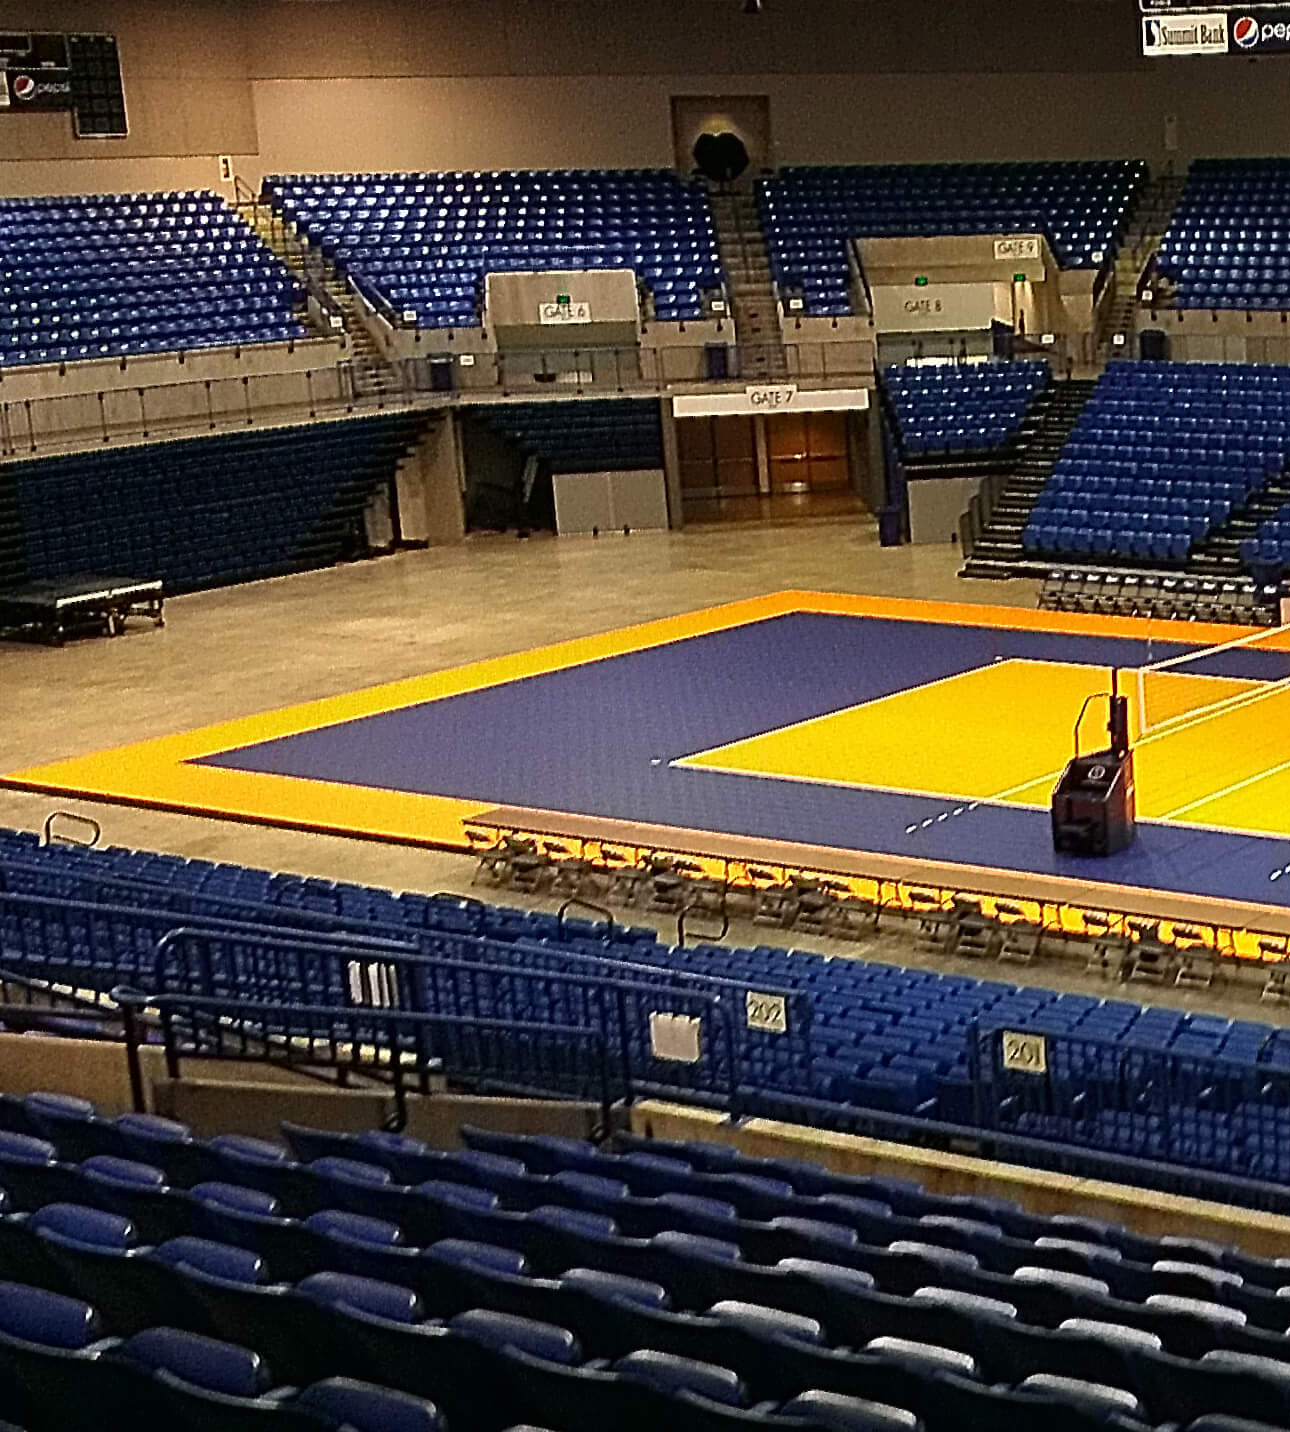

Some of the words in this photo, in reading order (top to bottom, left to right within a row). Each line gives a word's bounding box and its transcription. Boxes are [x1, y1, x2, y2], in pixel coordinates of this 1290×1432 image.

[1161, 25, 1198, 45] Summit
[1200, 24, 1226, 44] Bank
[998, 240, 1025, 255] GATE
[904, 300, 931, 313] GATE
[750, 391, 781, 405] GATE
[785, 390, 795, 403] 7
[749, 999, 783, 1026] 202
[1007, 1039, 1041, 1066] 201
